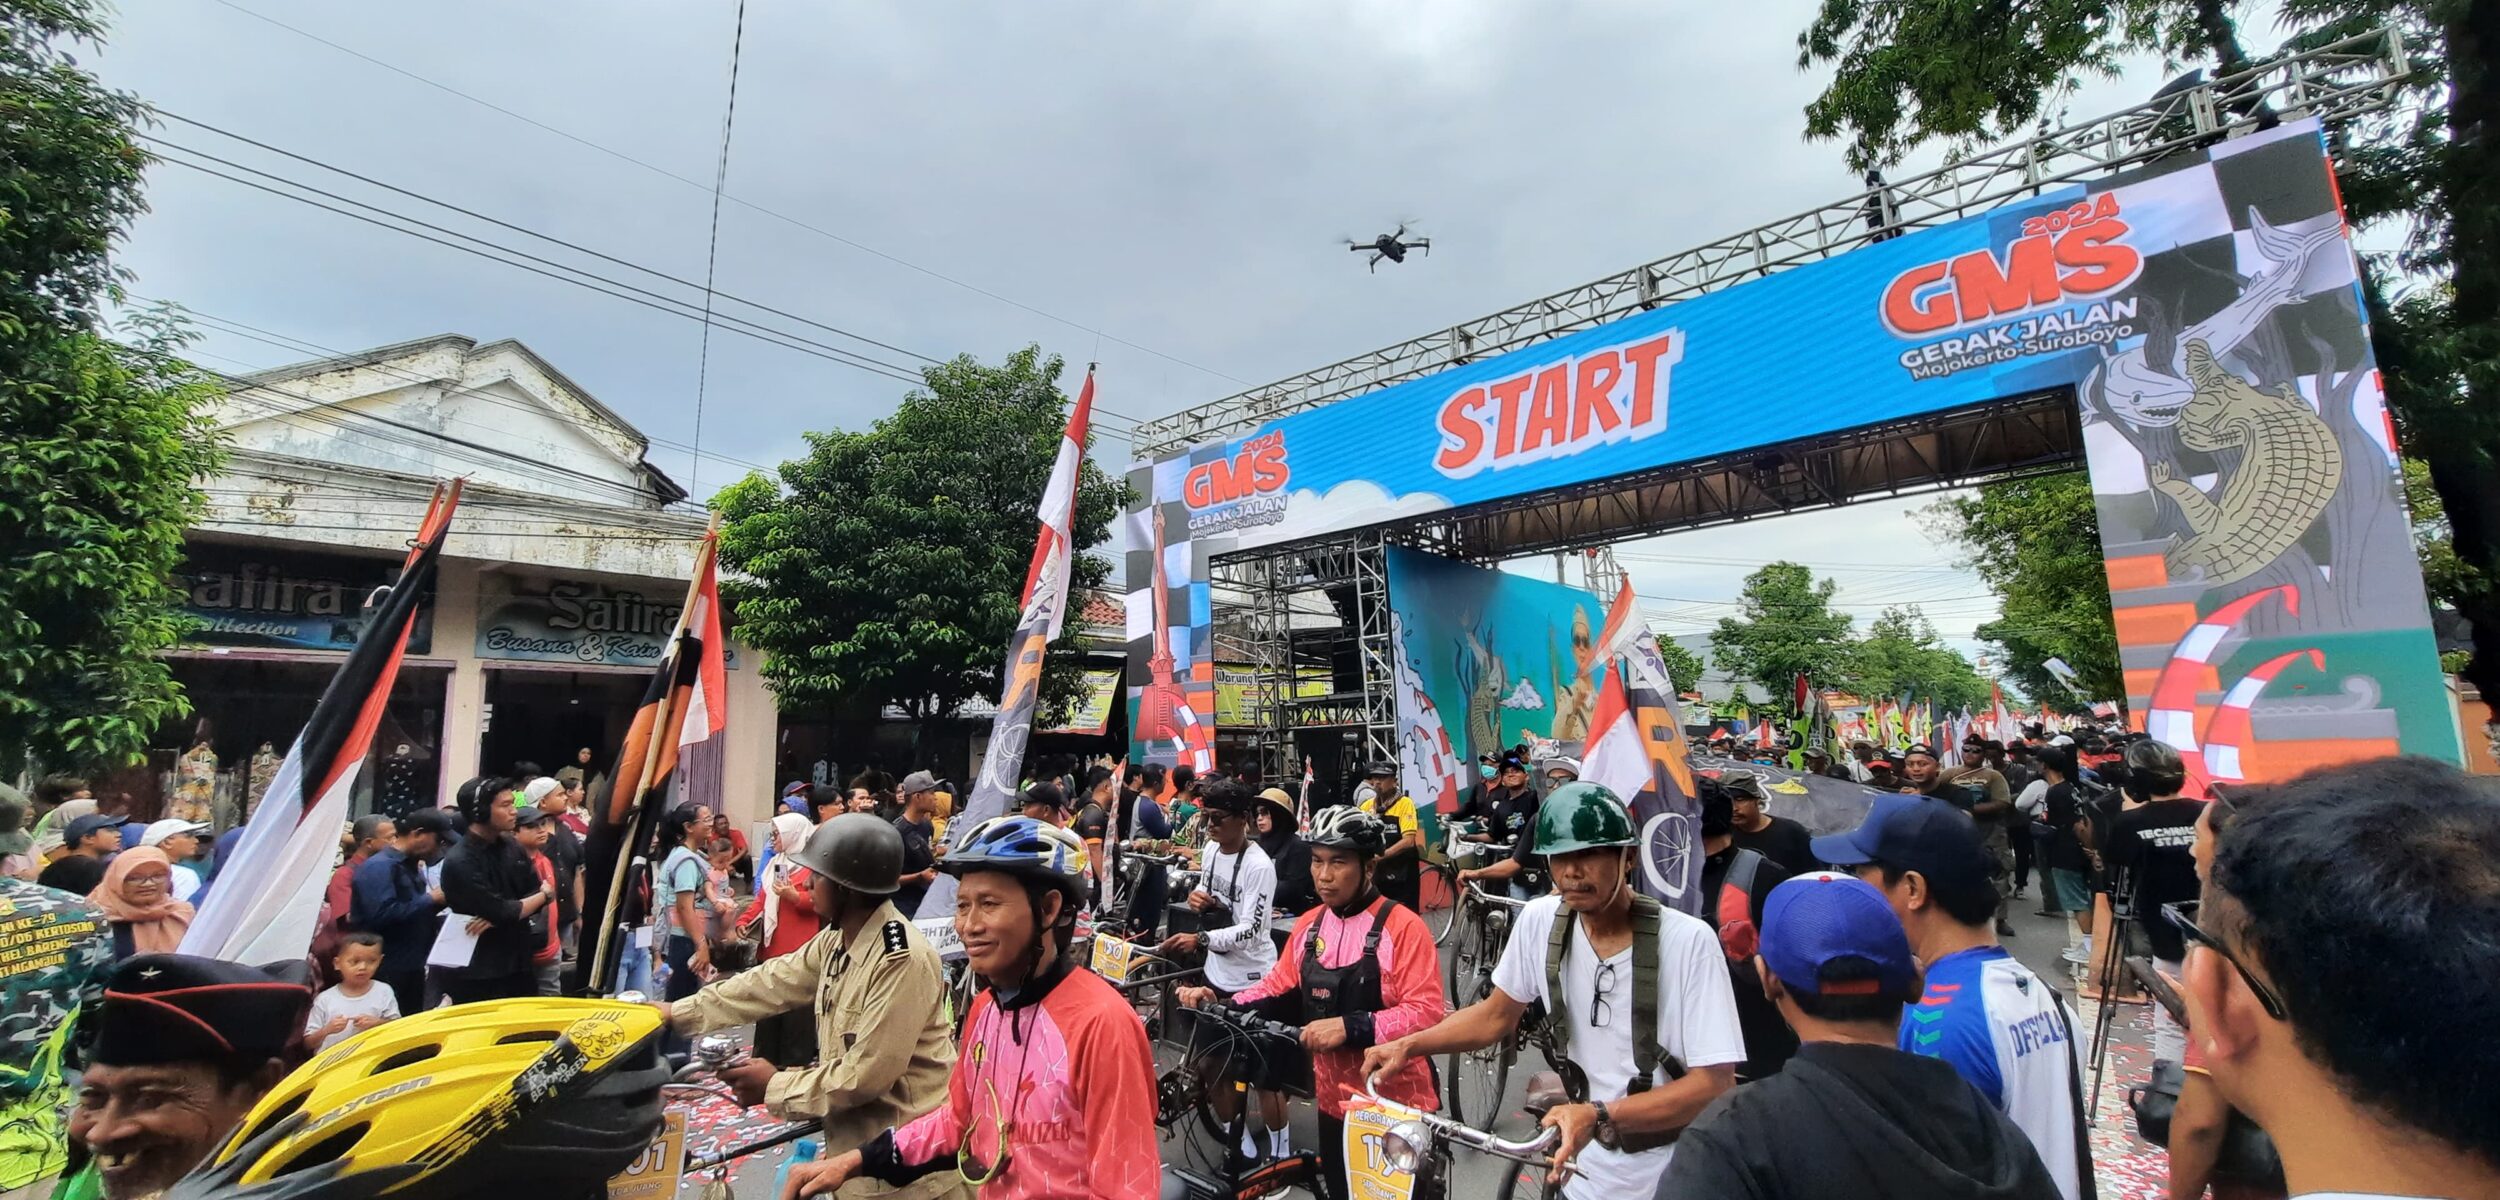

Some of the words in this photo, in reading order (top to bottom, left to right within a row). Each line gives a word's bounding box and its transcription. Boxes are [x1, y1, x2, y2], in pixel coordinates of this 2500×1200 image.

[2023, 192, 2120, 236] 2024
[1883, 217, 2141, 335] GMS
[1900, 323, 2016, 368] GERAK
[2021, 297, 2138, 340] JALAN
[1912, 324, 2133, 381] Mojokerto-Suroboyo
[1438, 335, 1669, 470] START
[1243, 430, 1284, 453] 2024
[1184, 446, 1289, 509] GMS
[1188, 508, 1234, 530] GERAK
[1236, 496, 1287, 518] JALAN
[1191, 512, 1284, 539] Mojokerto-Suroboyo
[192, 561, 343, 615] afira
[488, 628, 574, 655] Busana
[577, 633, 604, 661] &
[607, 637, 660, 658] Kain
[1215, 670, 1255, 688] Warung
[26, 937, 72, 956] BARENG
[530, 1062, 568, 1103] BEYOND
[559, 1055, 589, 1083] GREEN
